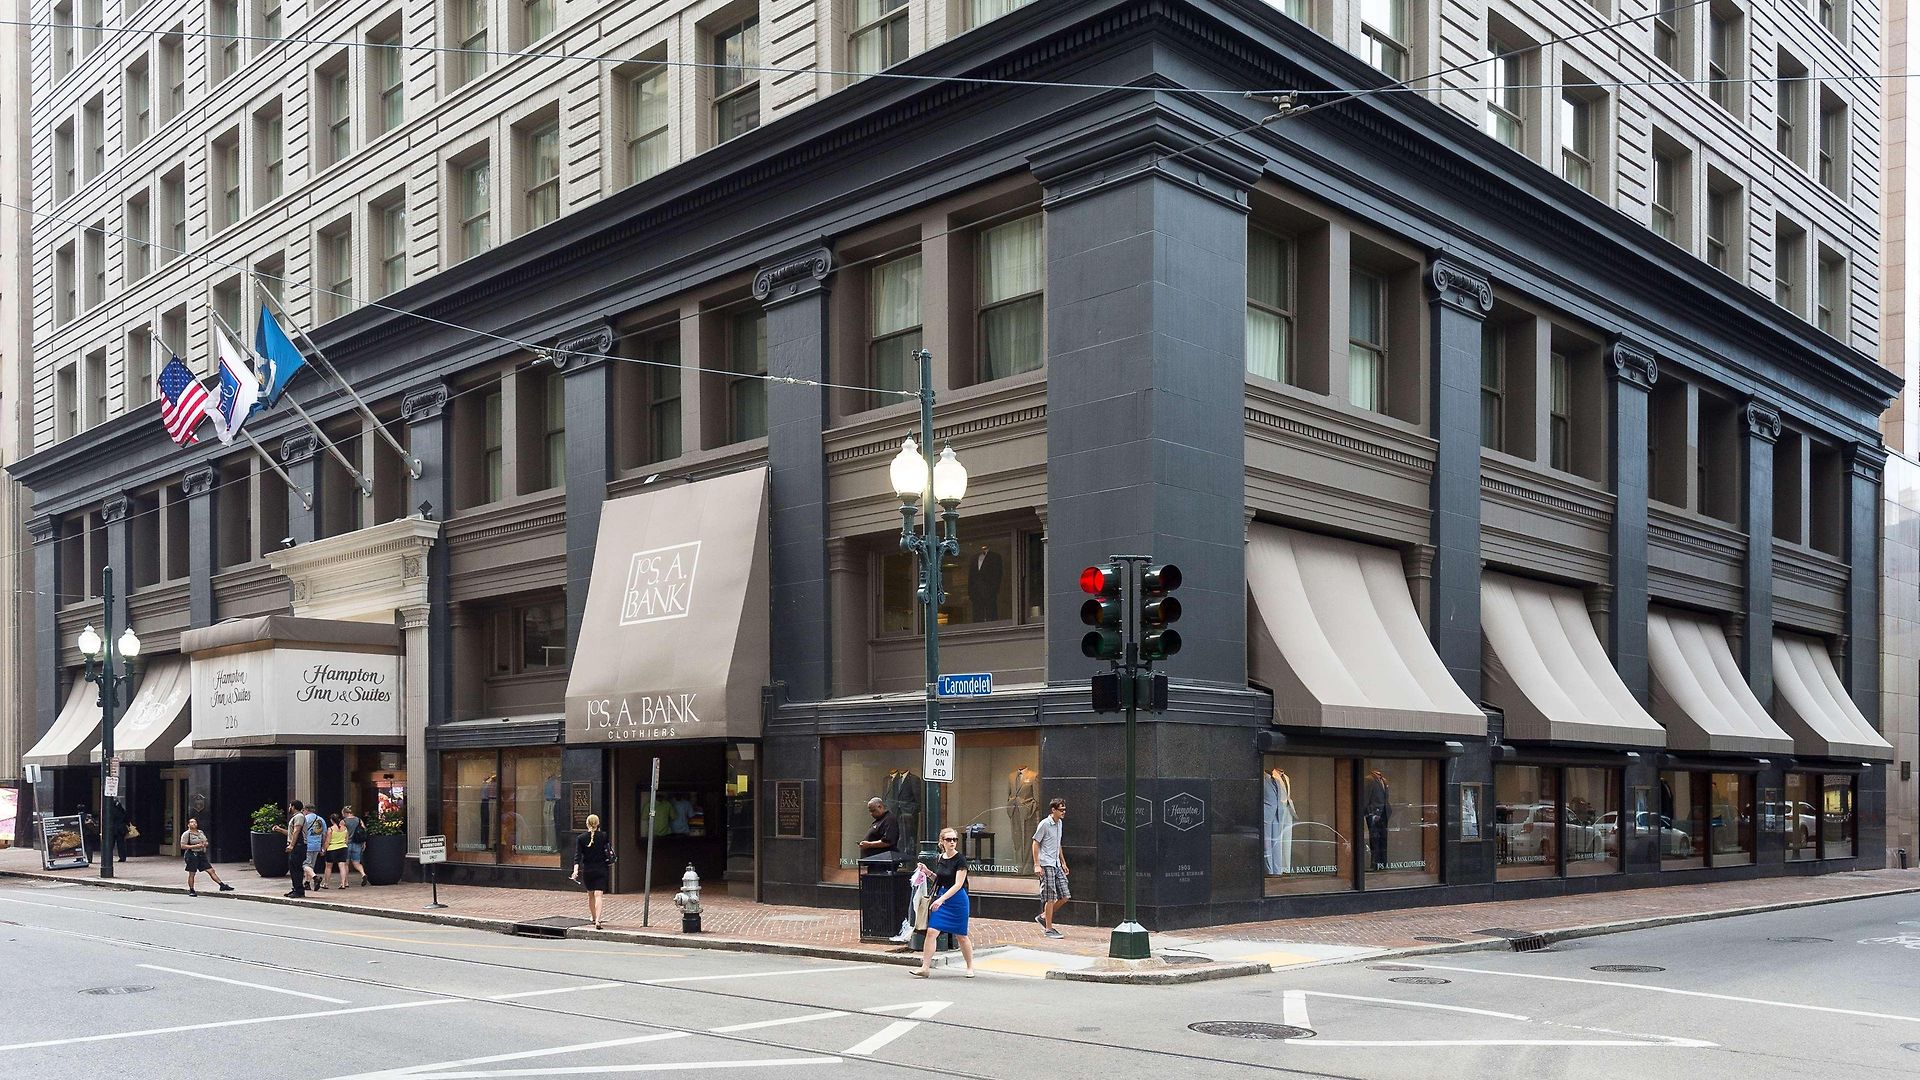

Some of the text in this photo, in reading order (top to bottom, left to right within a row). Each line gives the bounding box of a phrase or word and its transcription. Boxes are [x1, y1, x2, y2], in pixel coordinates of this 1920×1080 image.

[664, 552, 687, 582] A.
[625, 583, 685, 618] BANK
[213, 669, 247, 690] Hampton
[303, 664, 385, 684] Hampton
[945, 676, 990, 693] Carondelet
[211, 690, 227, 707] Inn
[231, 687, 251, 705] Suites
[297, 685, 391, 703] Inn & Suites
[615, 698, 637, 726] A.
[642, 693, 700, 725] BANK
[225, 715, 238, 729] 226
[330, 712, 360, 726] 226
[608, 727, 675, 739] CLOTHIERS
[934, 736, 948, 747] NO
[931, 747, 949, 757] TURN
[935, 758, 945, 767] ON
[932, 769, 947, 777] RED
[1167, 804, 1201, 817] Hampton
[968, 864, 1019, 873] ANK CLOTHIERS
[1296, 865, 1311, 873] BANK
[1310, 864, 1338, 873] CLOTHIERS
[1390, 861, 1403, 869] BANK
[1403, 860, 1427, 869] CLOTHIERS
